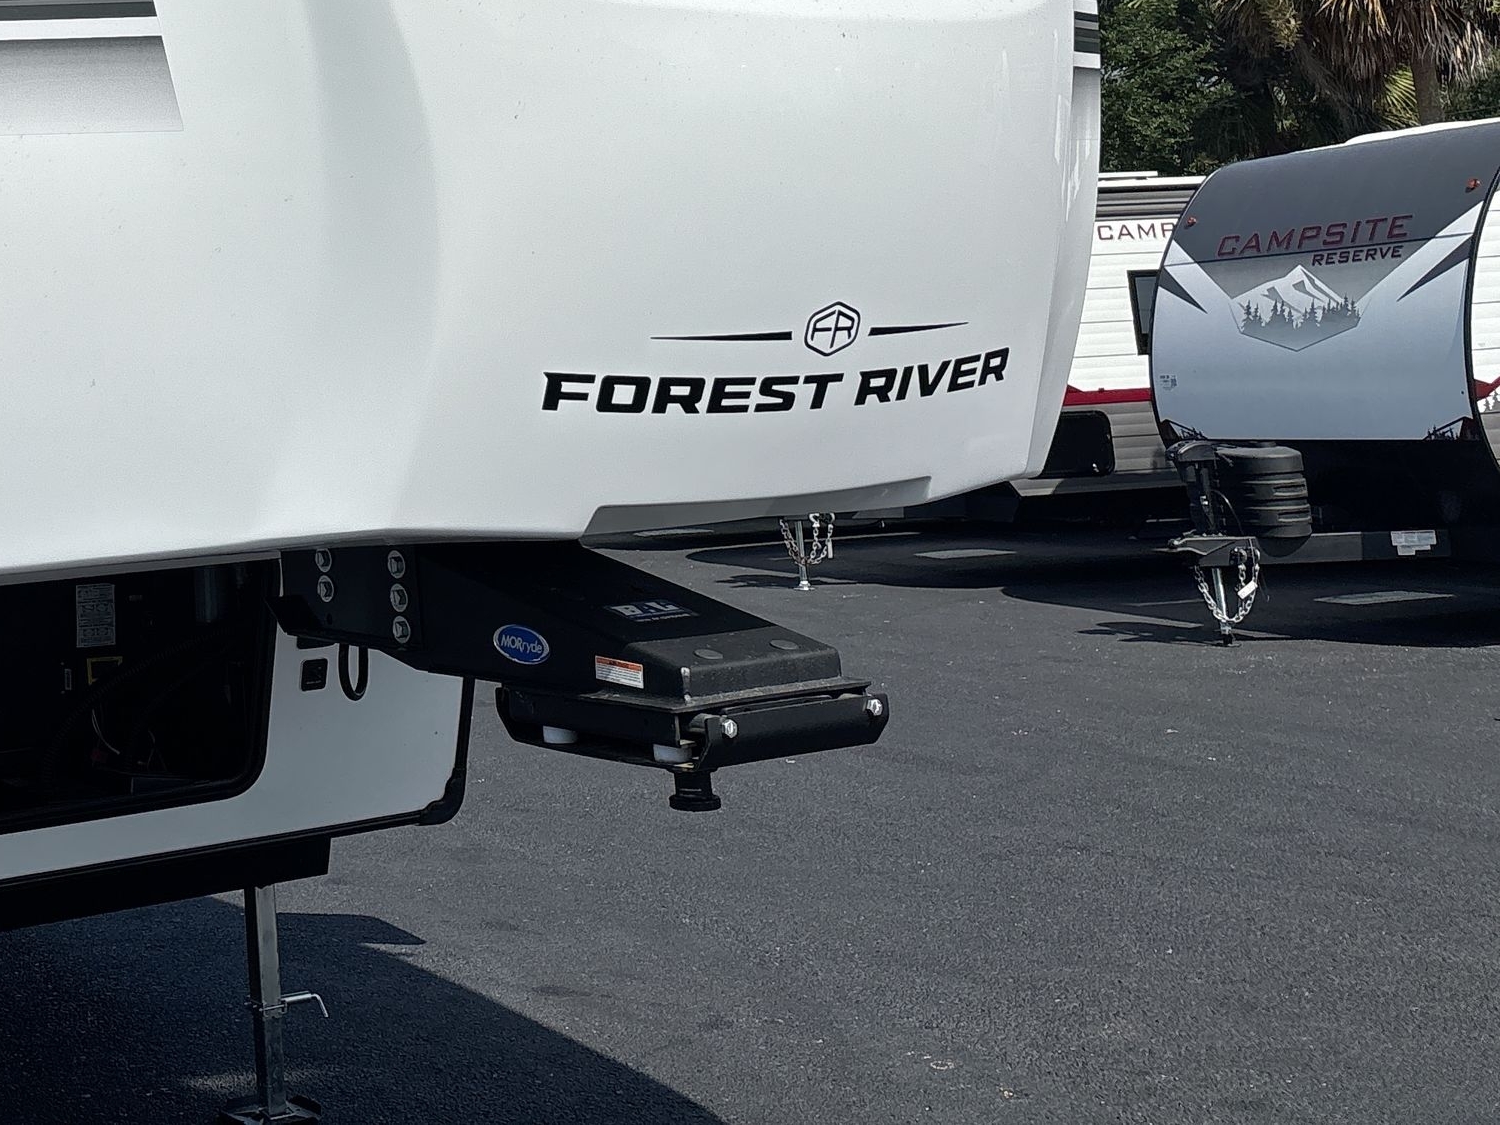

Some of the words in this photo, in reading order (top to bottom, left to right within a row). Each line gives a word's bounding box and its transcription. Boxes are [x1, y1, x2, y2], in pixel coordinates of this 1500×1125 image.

[1216, 214, 1414, 257] CAMPSITE
[1311, 245, 1405, 266] RESERVE
[542, 371, 843, 414] FOREST
[854, 346, 1011, 406] RIVER
[500, 633, 543, 654] MORryde
